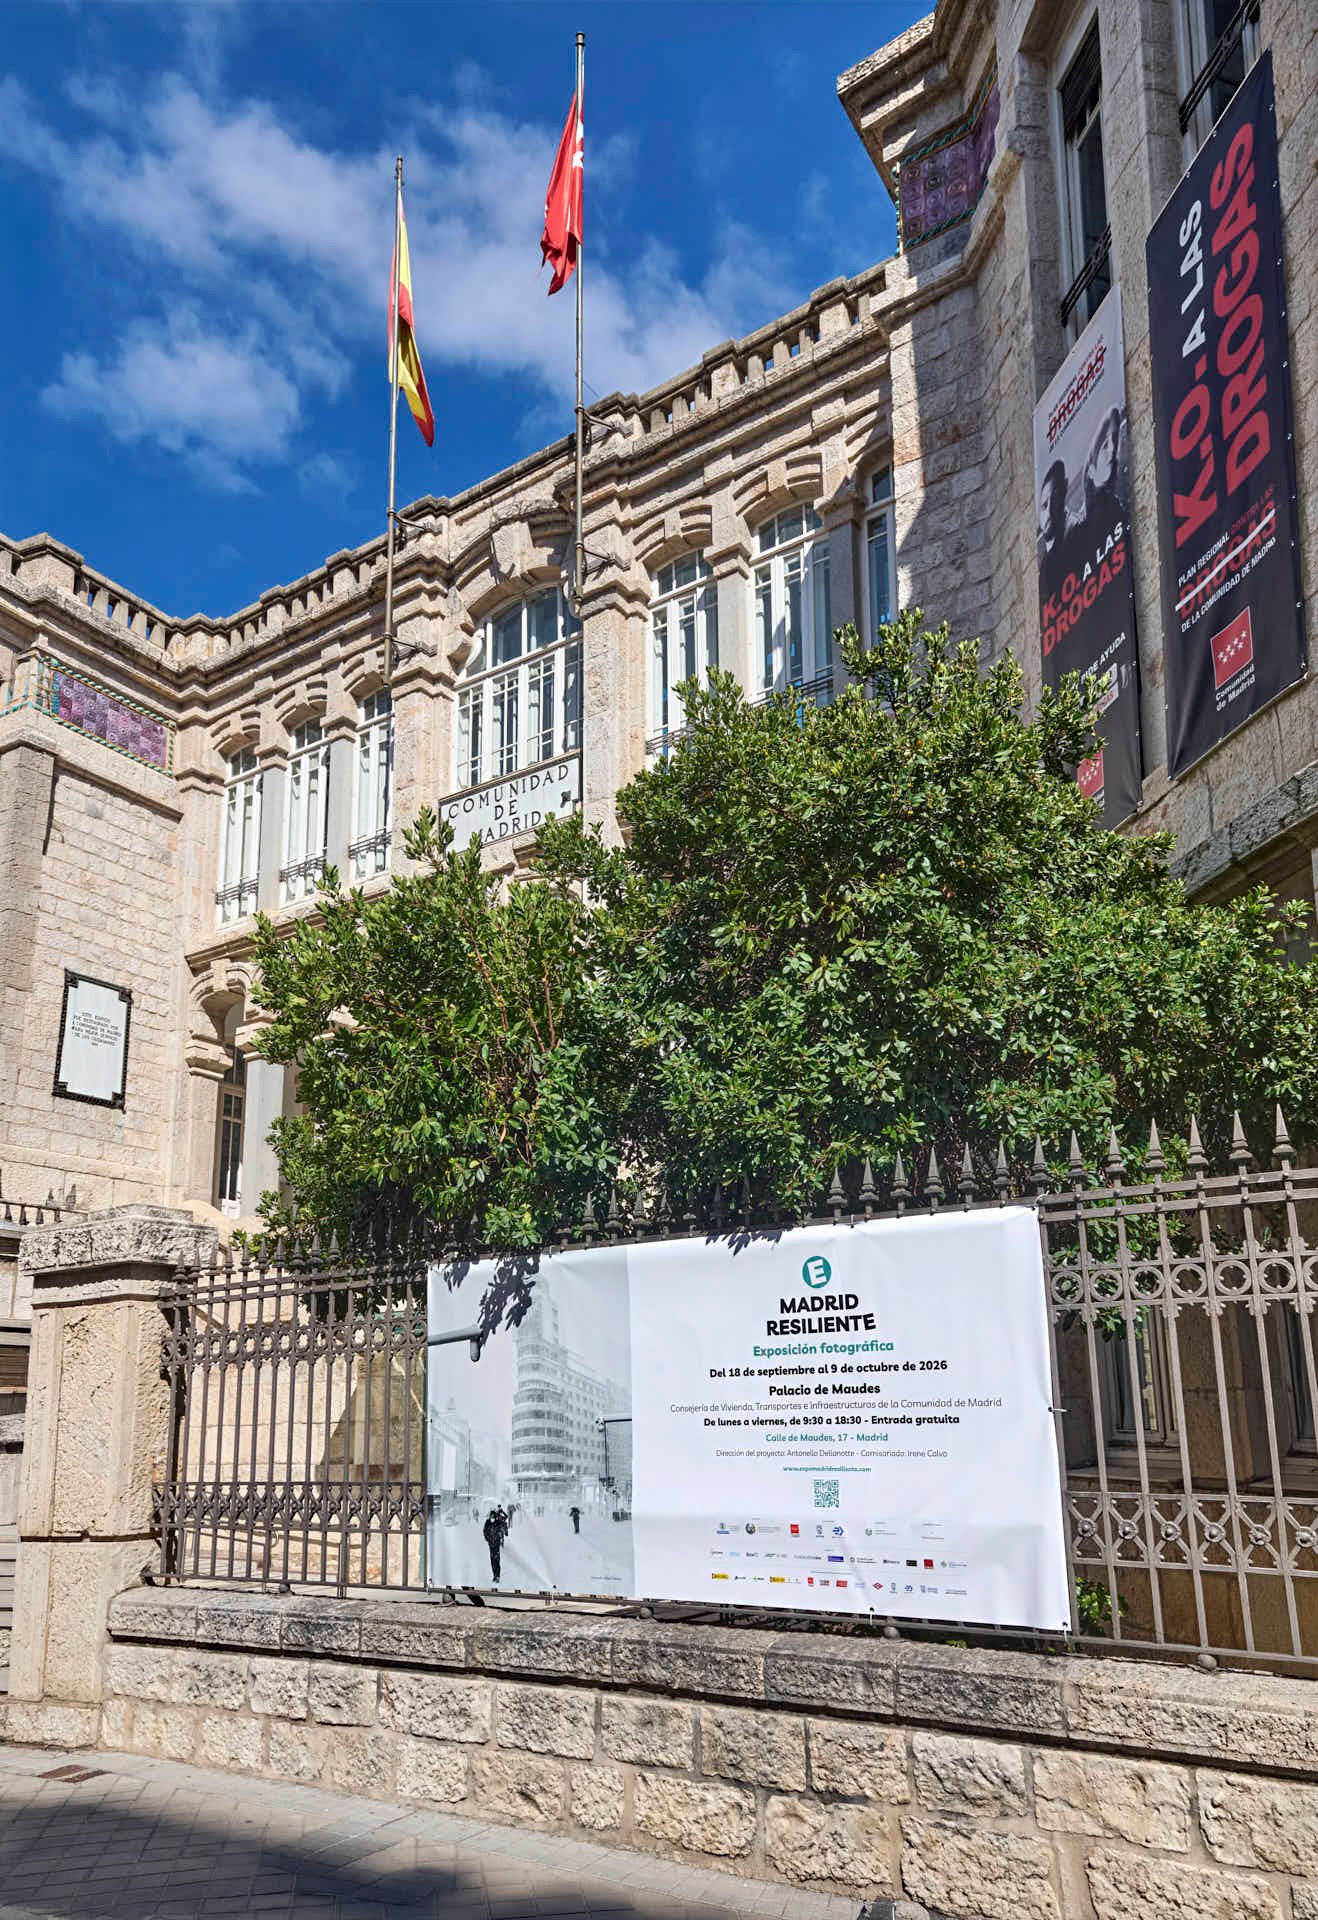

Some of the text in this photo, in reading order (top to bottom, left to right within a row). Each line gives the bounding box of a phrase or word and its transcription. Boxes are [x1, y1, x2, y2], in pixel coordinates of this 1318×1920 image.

[1210, 122, 1272, 497] DROGAS
[1170, 200, 1218, 549] K.O. A LAS
[1048, 345, 1105, 443] DROGAS
[1042, 521, 1124, 629] K.O. A LAS
[1178, 563, 1197, 588] PLAN
[1197, 531, 1231, 569] REGIONAL
[1178, 500, 1278, 620] DROGAS
[1042, 541, 1127, 657] DROGAS
[1181, 620, 1192, 633] DE
[1192, 610, 1201, 625] LA
[1201, 573, 1241, 616] COMUNIDAD
[1241, 565, 1251, 579] DE
[1100, 631, 1126, 665] AYUDA
[1215, 664, 1255, 701] Comunidad
[1216, 673, 1256, 712] de Madrid
[448, 764, 569, 819] COMUNIDAD
[480, 810, 542, 843] ADRID
[494, 799, 518, 821] DE
[780, 1294, 860, 1315] MADRID
[766, 1314, 877, 1337] RESILIENTE
[753, 1340, 895, 1359] Exposición fotográfica
[709, 1360, 948, 1378] Del 18 de septiembre al 9 de octubre de 2026
[709, 1403, 720, 1412] de
[756, 1402, 801, 1413] Transportes
[810, 1399, 876, 1410] Infraestructuras
[878, 1400, 889, 1409] de
[890, 1399, 899, 1408] la
[900, 1398, 952, 1408] Comunidad
[954, 1397, 966, 1408] de
[967, 1396, 1002, 1408] Madrid
[769, 1383, 881, 1397] Palacio de Maudes
[704, 1418, 716, 1427] De
[717, 1417, 742, 1427] lunes
[751, 1417, 788, 1428] viernes,
[789, 1417, 801, 1426] de
[803, 1416, 824, 1426] 9:30
[826, 1417, 832, 1425] a
[835, 1416, 862, 1425] 18:30
[871, 1415, 913, 1425] Entrada
[915, 1414, 960, 1427] gratuita
[765, 1433, 787, 1442] Calle
[788, 1433, 799, 1442] de
[800, 1433, 836, 1444] Maudes,
[838, 1433, 848, 1442] 17
[856, 1432, 889, 1442] Madrid
[745, 1449, 756, 1458] del
